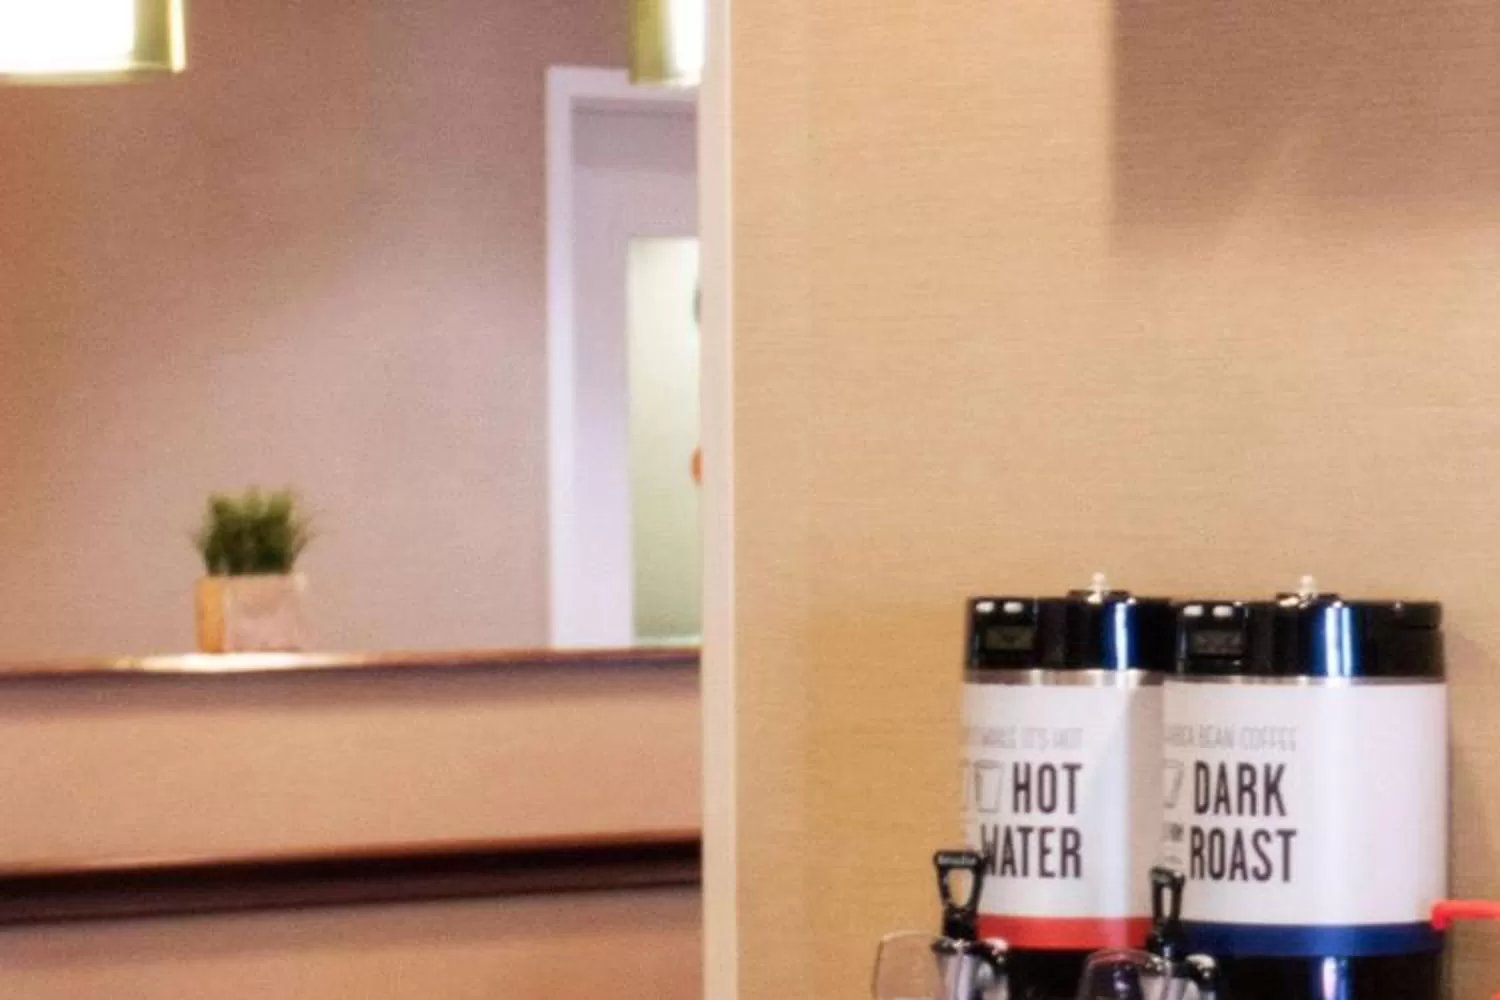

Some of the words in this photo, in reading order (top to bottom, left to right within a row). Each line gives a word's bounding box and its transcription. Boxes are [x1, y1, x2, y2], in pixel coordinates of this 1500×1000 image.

[1240, 726, 1297, 751] COFFEE
[1012, 761, 1083, 815] HOT
[1194, 760, 1287, 817] DARK
[980, 824, 1082, 878] WATER
[1190, 825, 1298, 883] ROAST
